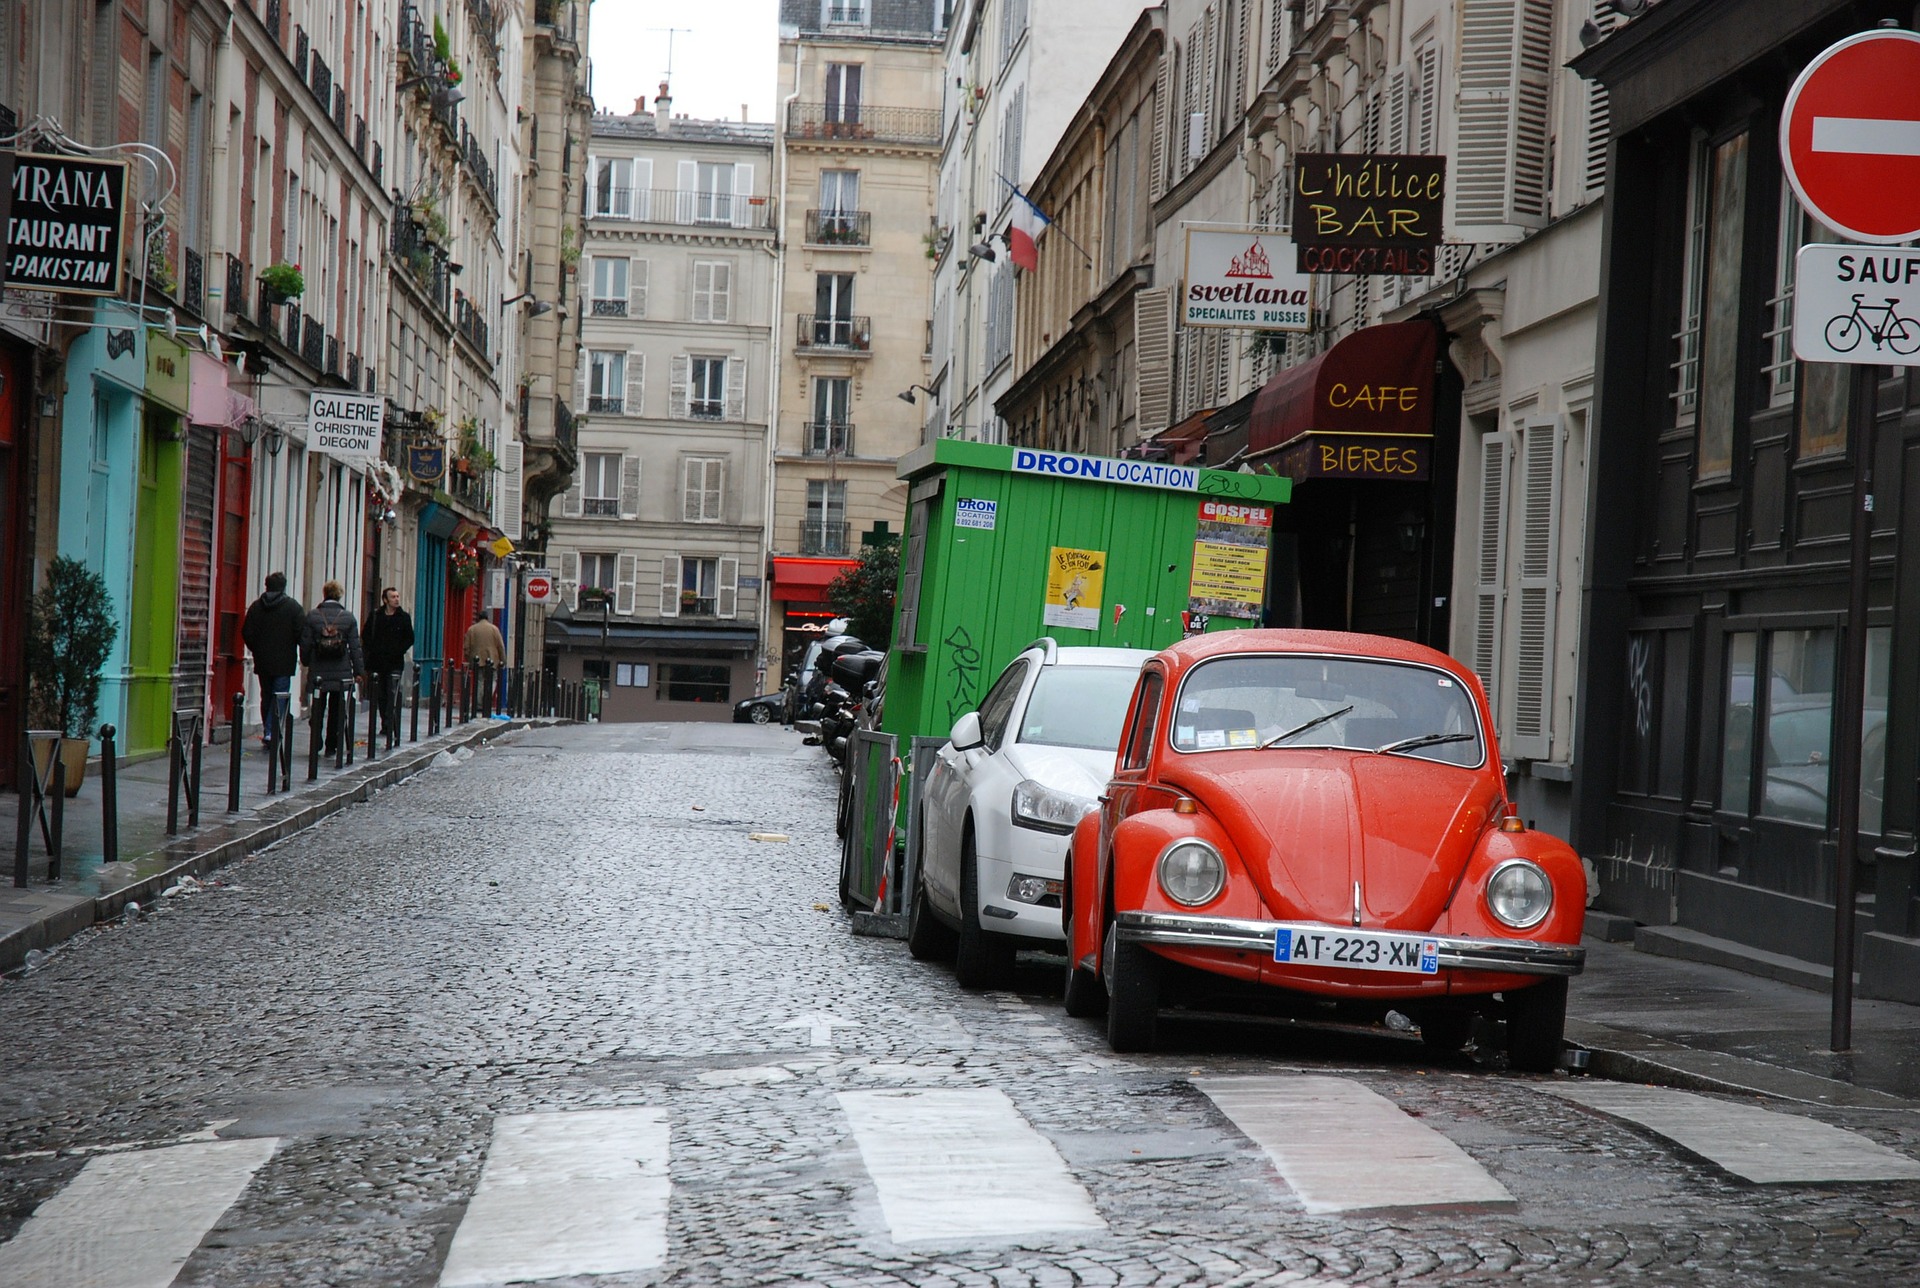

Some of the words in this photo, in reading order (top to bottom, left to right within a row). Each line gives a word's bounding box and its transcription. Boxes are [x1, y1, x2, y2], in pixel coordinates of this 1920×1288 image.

[1299, 158, 1440, 199] L'hélice
[1309, 204, 1428, 238] BAR
[1304, 246, 1429, 273] COCKTAILS
[1837, 255, 1920, 284] SAUF
[1188, 281, 1308, 306] svetlana
[1188, 306, 1256, 321] SPECIALITES
[1263, 310, 1307, 323] RUSSES
[1329, 383, 1419, 412] CAFE
[313, 399, 380, 422] GALERIE
[314, 421, 377, 437] CHRISTINE
[319, 435, 369, 450] DIEGONI
[1016, 451, 1102, 478] DRON
[1106, 461, 1194, 488] LOCATION
[1319, 444, 1418, 474] BIERES
[957, 511, 995, 520] LOCATION
[958, 500, 996, 512] DRON
[1203, 502, 1267, 520] GOSPEL
[1293, 934, 1421, 967] AT-223-XW
[1423, 957, 1436, 969] 75
